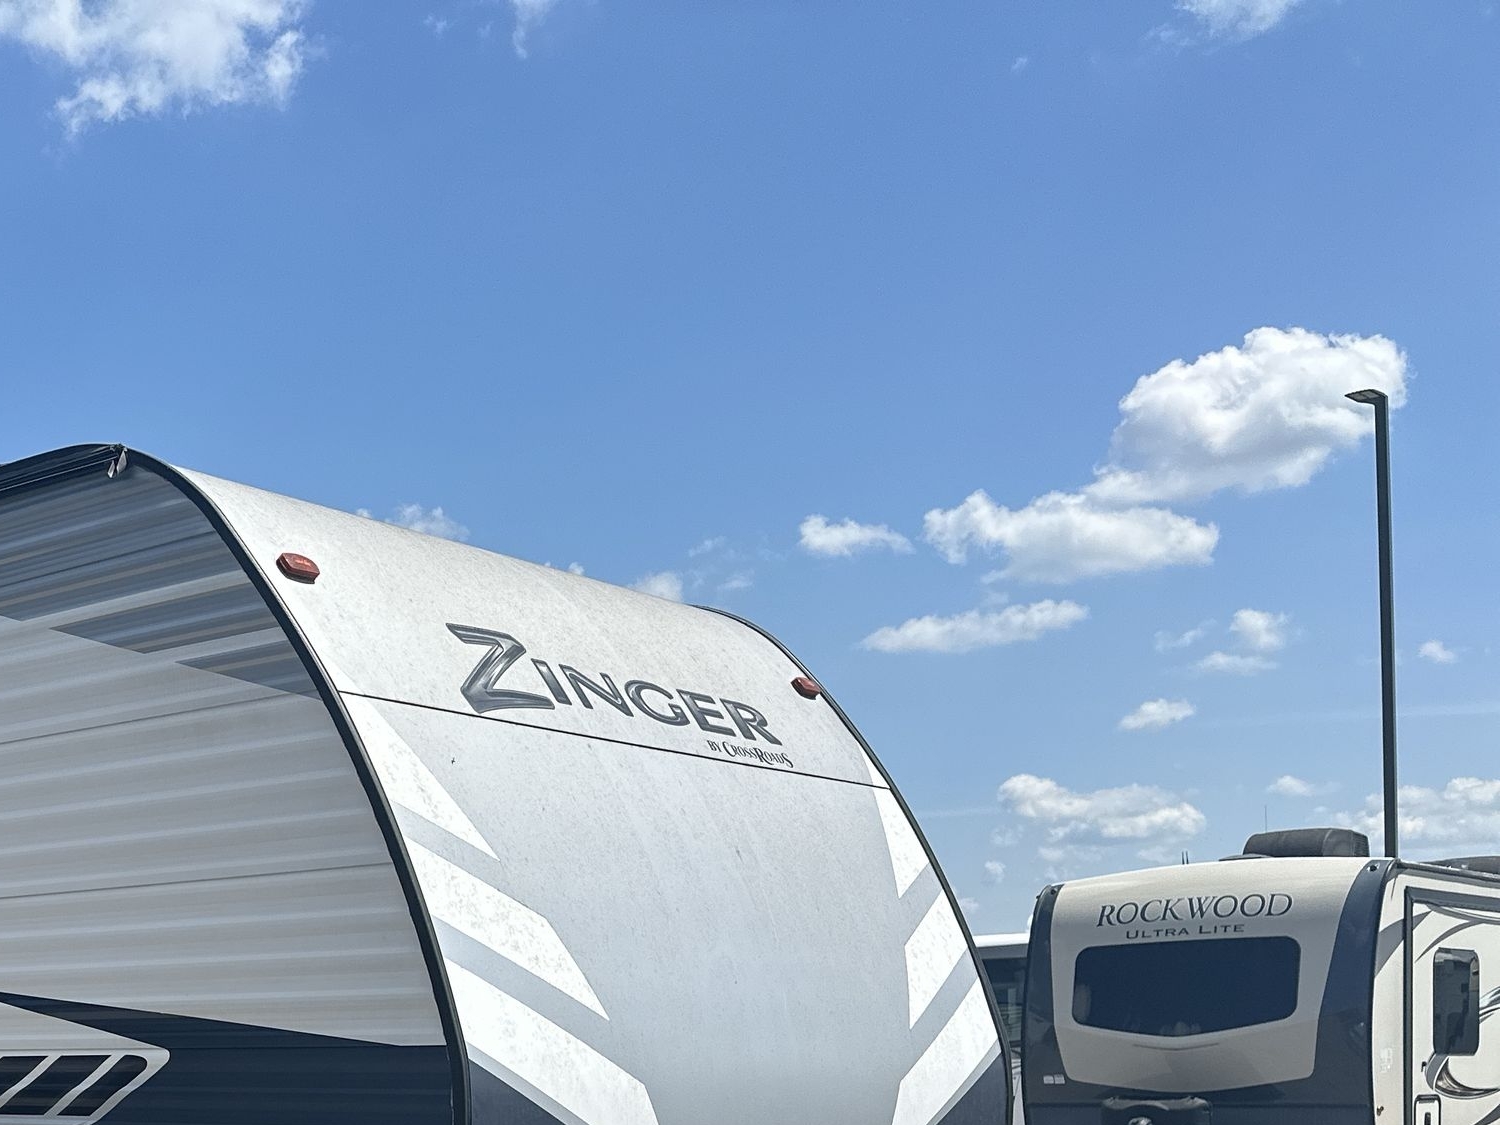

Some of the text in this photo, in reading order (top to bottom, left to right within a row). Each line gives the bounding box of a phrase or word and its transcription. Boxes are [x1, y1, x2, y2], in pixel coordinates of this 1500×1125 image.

[446, 622, 783, 746] ZINGER
[706, 739, 722, 753] BY
[1096, 893, 1293, 927] ROCKWOOD
[1126, 923, 1245, 940] ULTRA LITE
